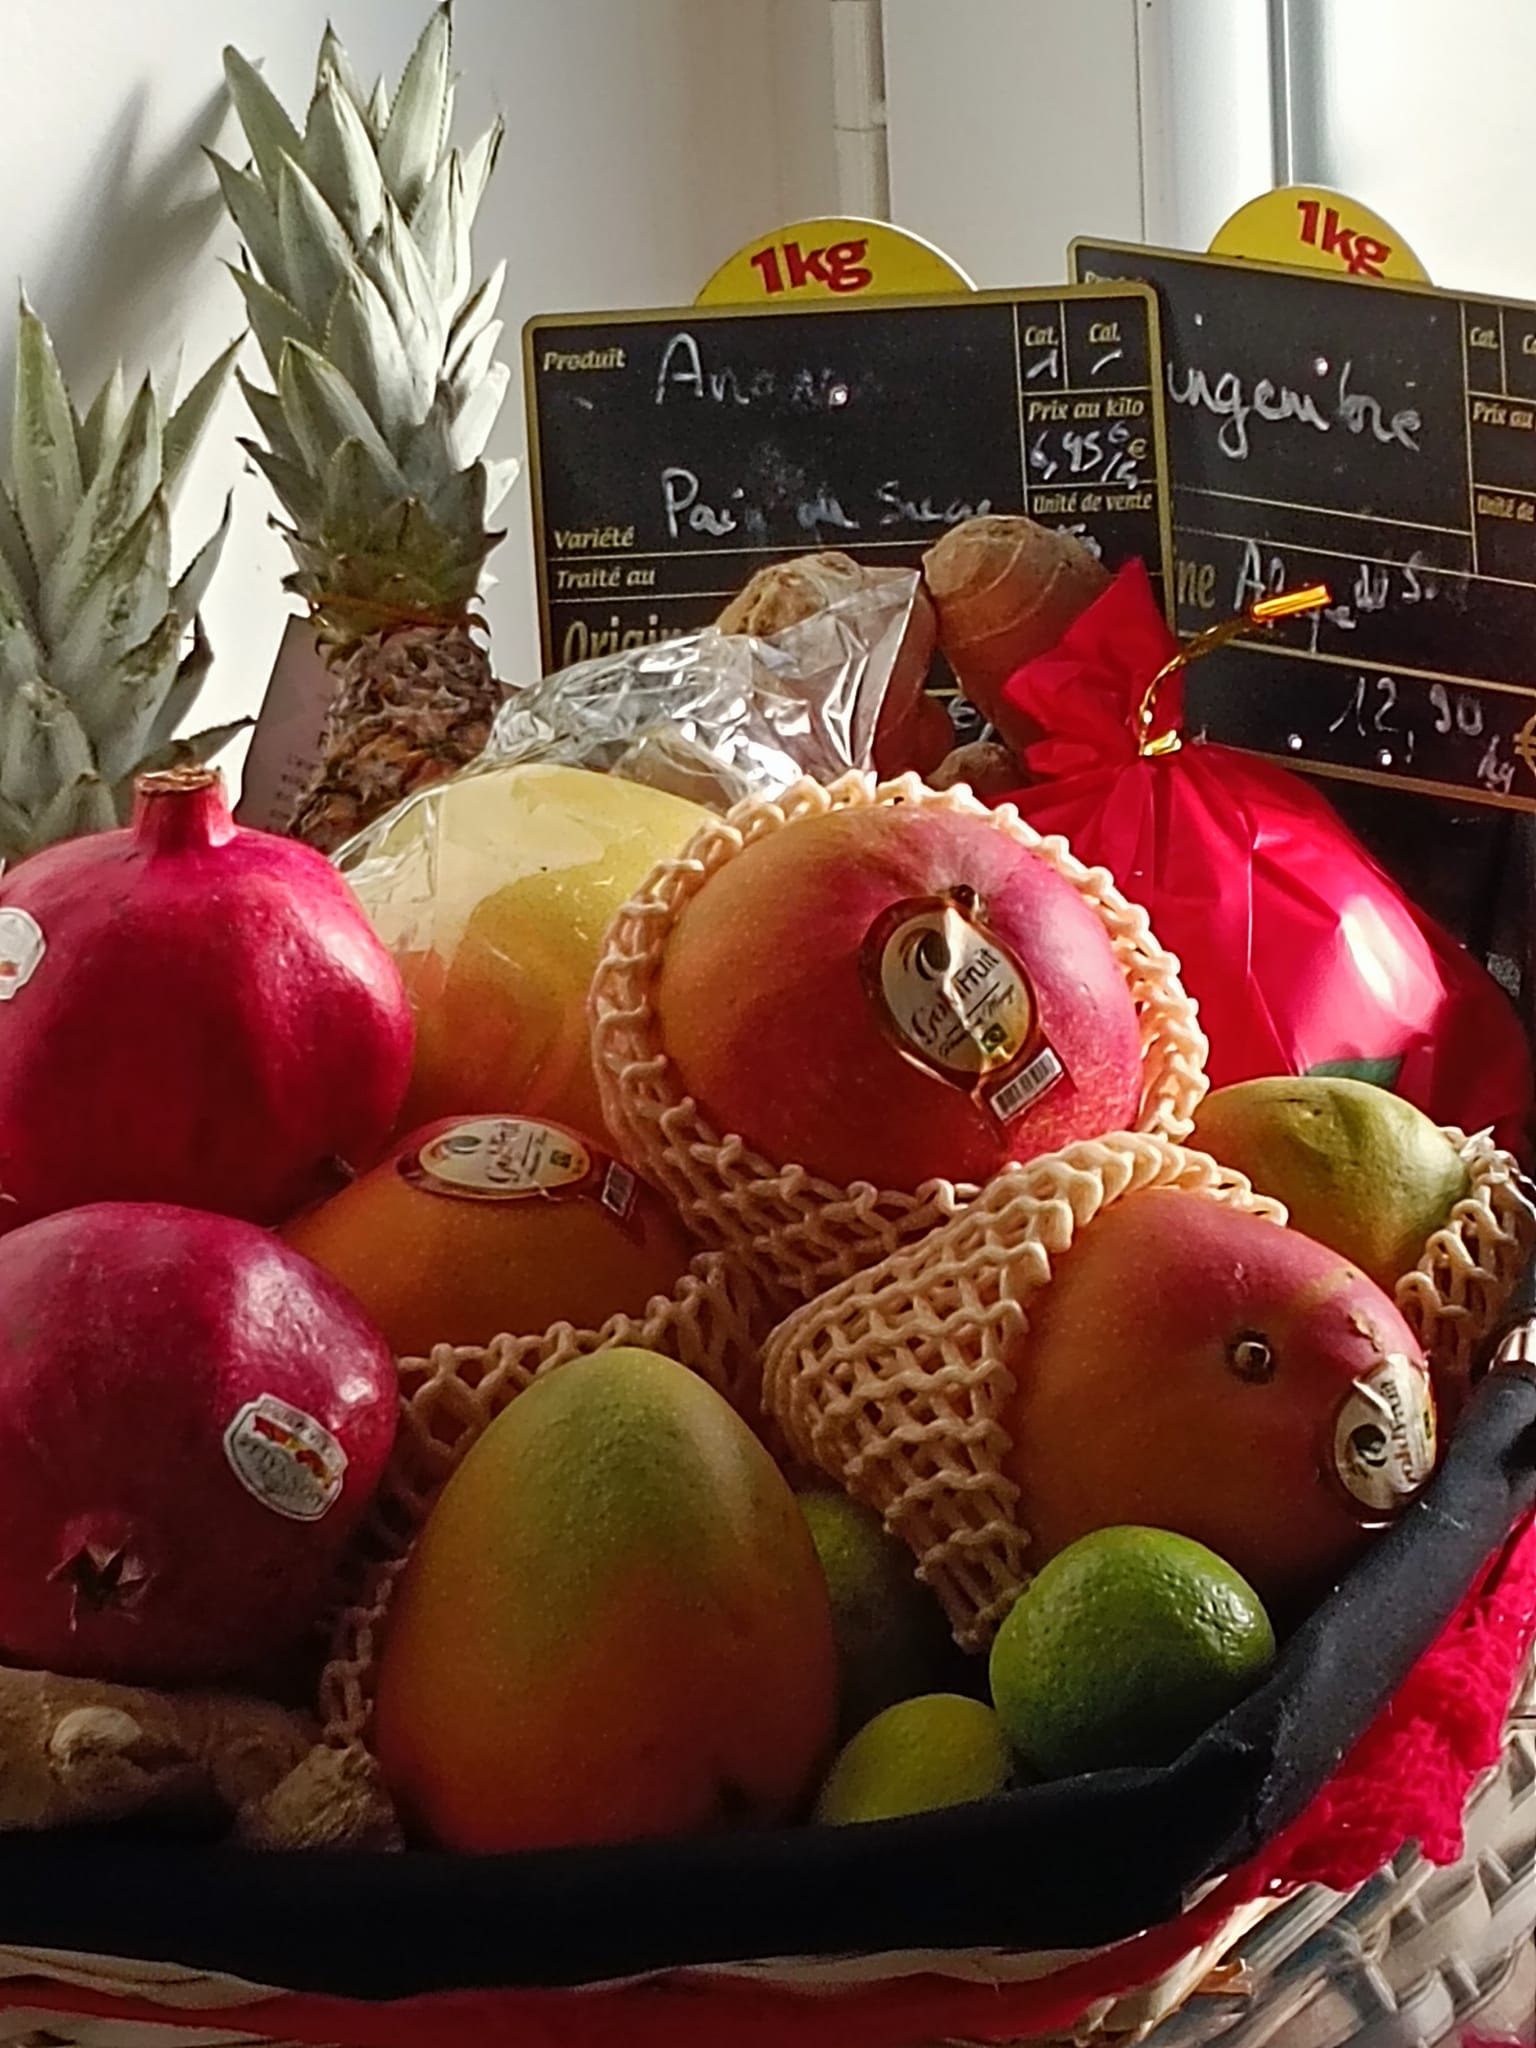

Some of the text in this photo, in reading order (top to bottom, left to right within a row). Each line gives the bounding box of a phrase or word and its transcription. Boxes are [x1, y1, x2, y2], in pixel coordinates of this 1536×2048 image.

[1297, 200, 1391, 280] 1kg
[751, 239, 872, 294] 1kg
[543, 348, 626, 371] Produit
[1028, 397, 1144, 421] Prix au kilo
[1472, 402, 1507, 425] Prix
[1080, 494, 1101, 512] de
[1105, 491, 1153, 511] vente
[554, 525, 635, 549] Variété
[557, 566, 656, 589] Traité au
